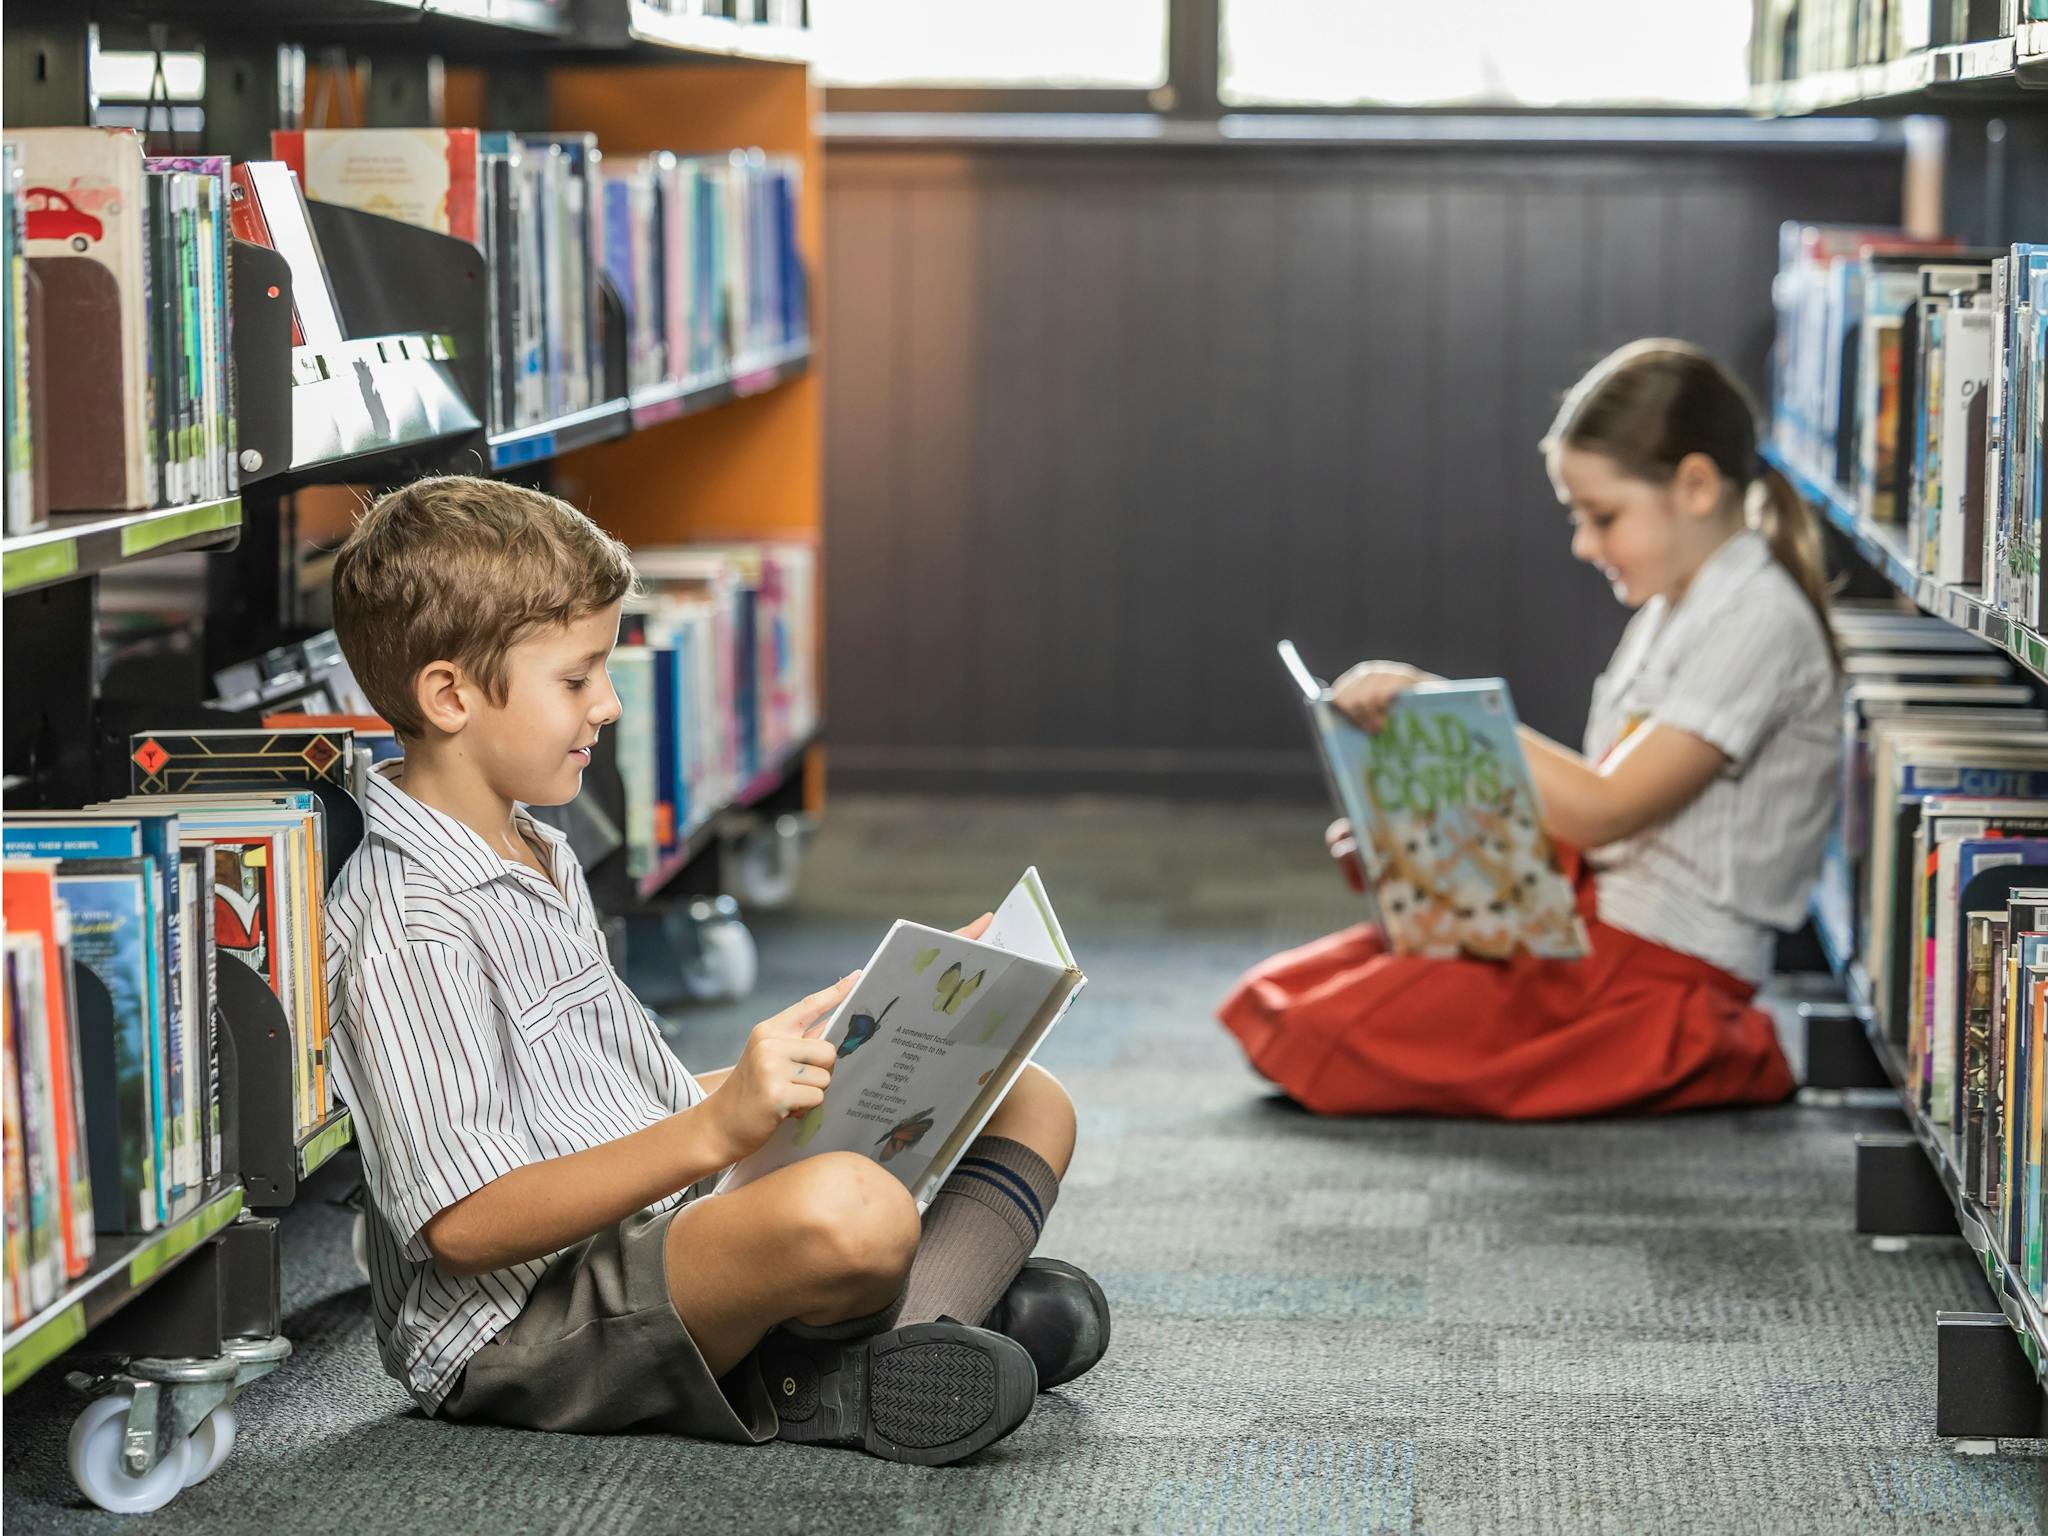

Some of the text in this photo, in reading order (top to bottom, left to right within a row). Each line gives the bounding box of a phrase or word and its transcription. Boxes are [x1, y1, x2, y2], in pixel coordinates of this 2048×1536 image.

[1366, 752, 1500, 814] COWS
[1963, 769, 2031, 796] CUTE
[167, 912, 181, 976] STARS
[208, 950, 218, 1006] TIME
[210, 1012, 218, 1048] WILL
[890, 1038, 928, 1050] introduction
[935, 1047, 947, 1056] the
[902, 1028, 934, 1041] somewhat
